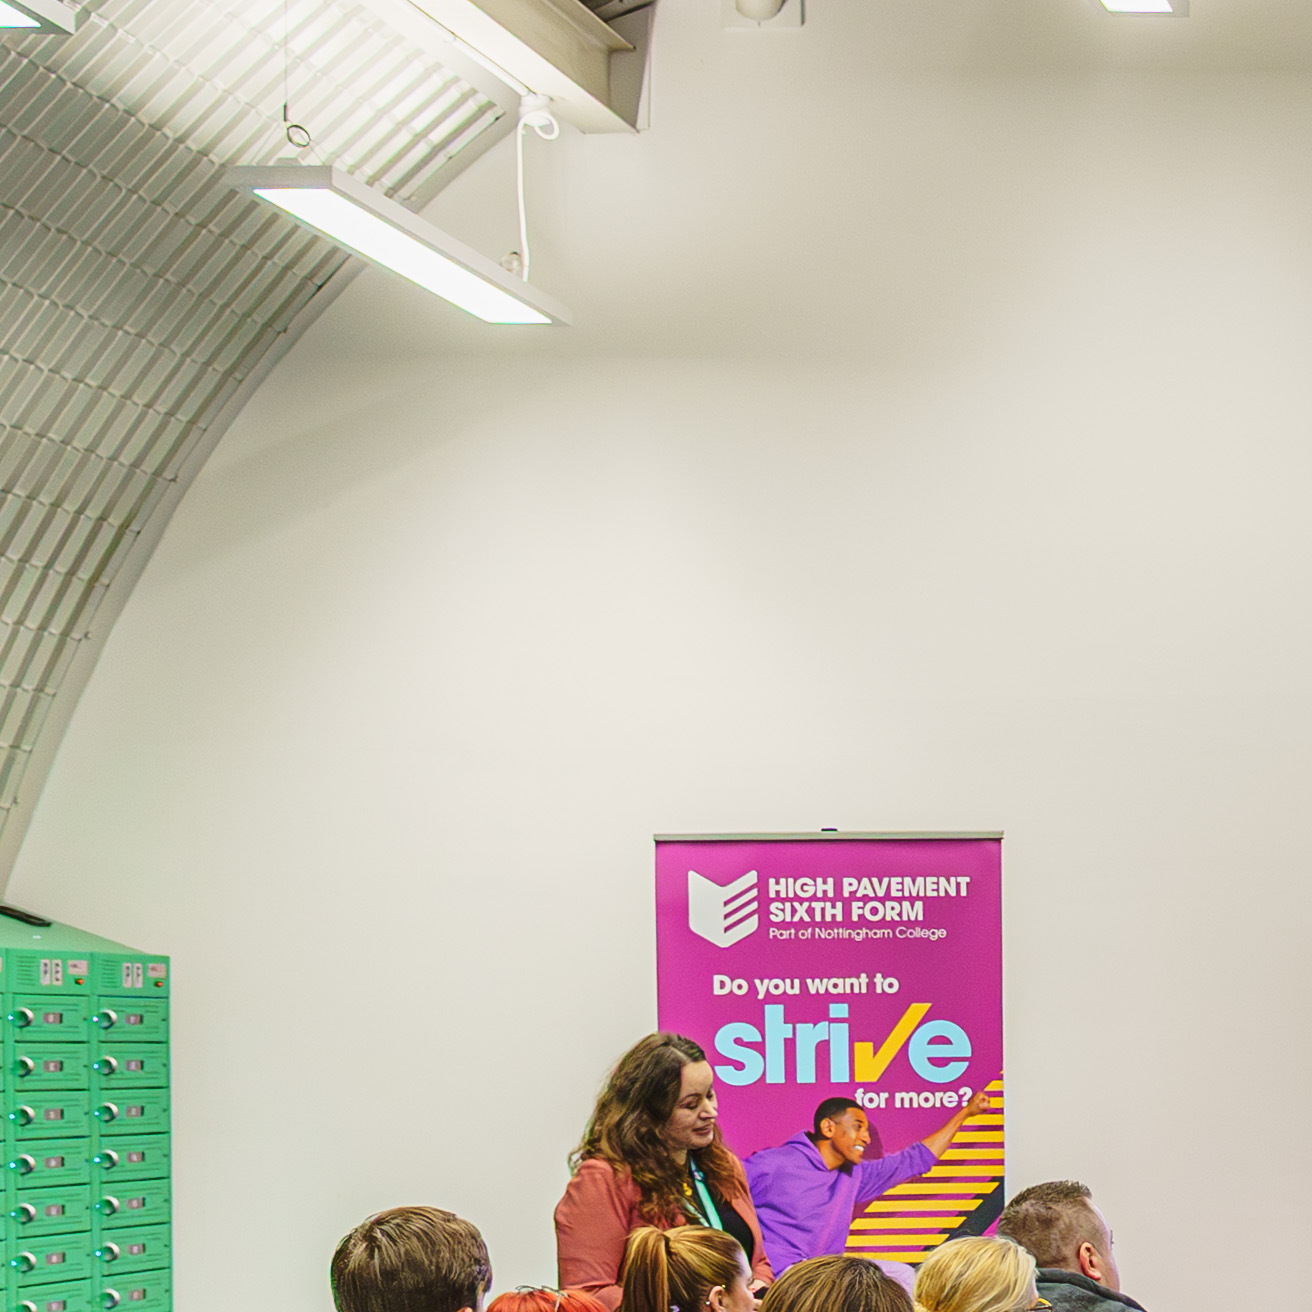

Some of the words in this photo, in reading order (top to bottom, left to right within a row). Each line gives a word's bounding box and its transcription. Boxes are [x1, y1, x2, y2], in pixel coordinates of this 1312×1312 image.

[768, 876, 835, 899] HIGH
[842, 876, 971, 898] PAVEMENT
[769, 901, 843, 923] SIXTH
[851, 900, 924, 922] FORM
[768, 927, 796, 940] Part
[798, 927, 813, 940] of
[814, 927, 893, 942] Nottingham
[895, 926, 947, 941] College
[712, 974, 749, 996] Do
[753, 978, 801, 1000] you
[805, 972, 869, 995] want
[873, 972, 900, 994] to
[714, 1003, 972, 1086] strive
[855, 1087, 889, 1109] for
[894, 1086, 973, 1109] more?
